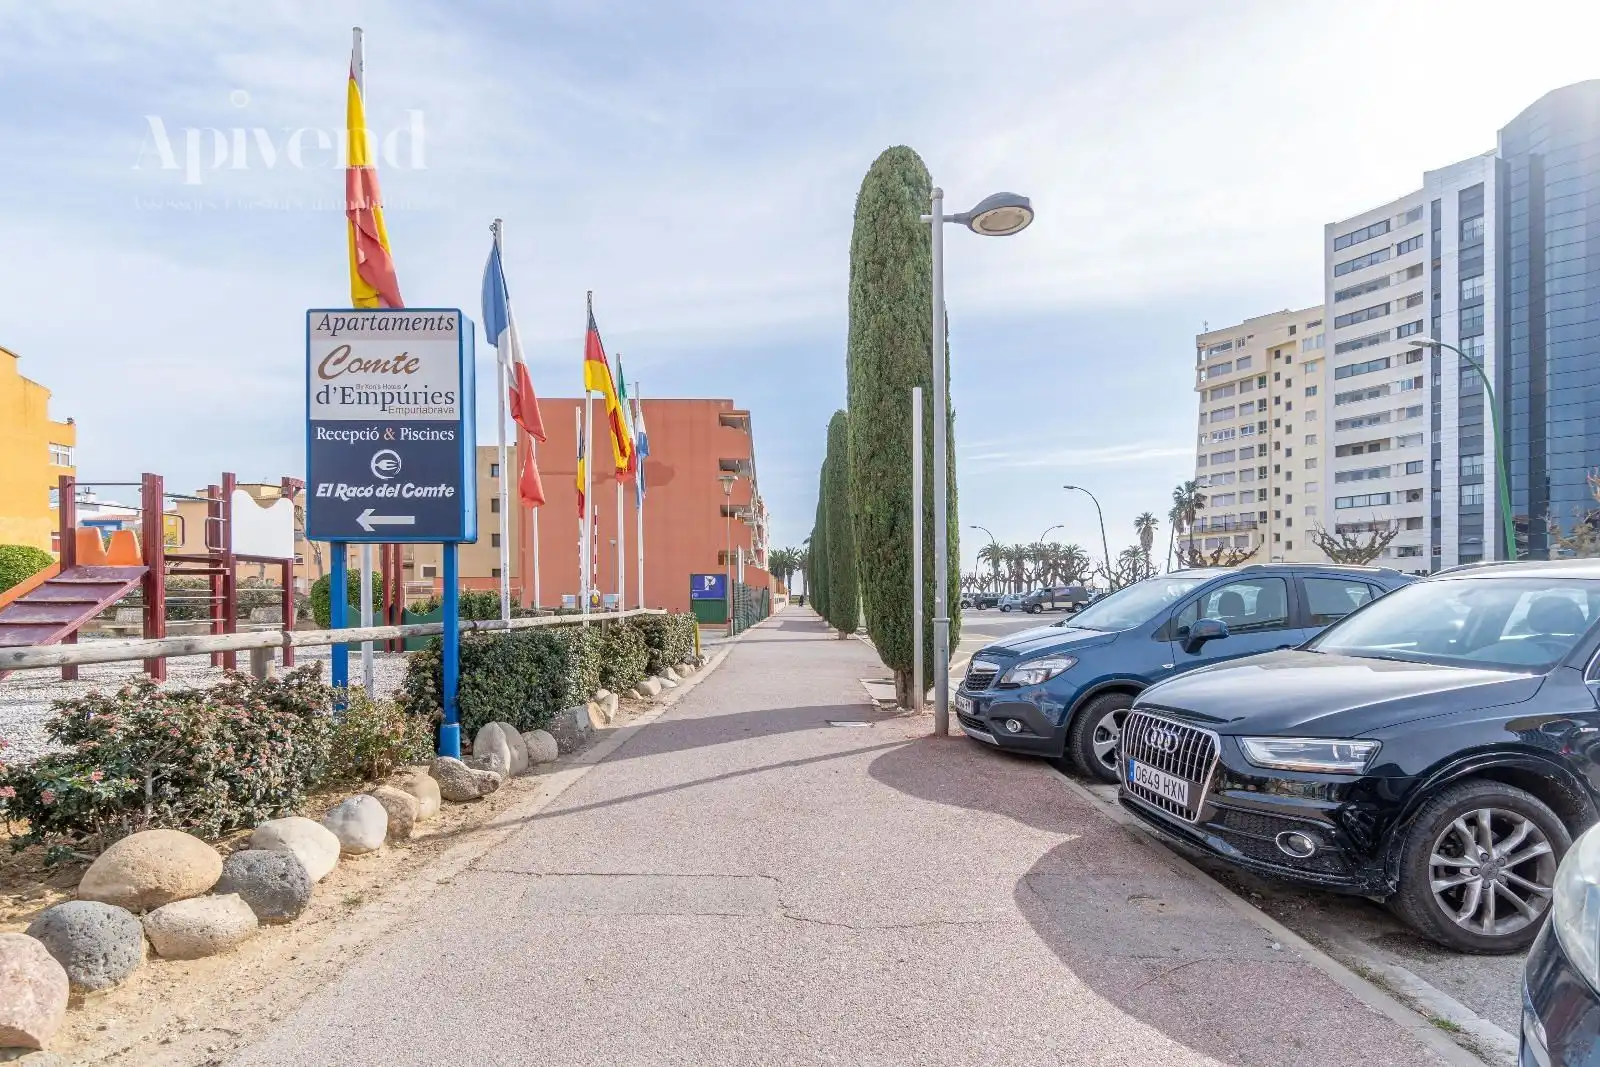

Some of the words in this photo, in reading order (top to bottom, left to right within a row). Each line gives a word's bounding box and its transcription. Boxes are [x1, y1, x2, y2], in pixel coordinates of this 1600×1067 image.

[316, 313, 455, 337] Apartaments
[317, 344, 420, 380] Comte
[388, 405, 455, 415] Empuriabrava
[316, 427, 379, 444] Recepció
[383, 427, 396, 441] &
[400, 427, 454, 441] Piscines
[316, 483, 333, 497] El
[335, 483, 374, 501] Racó
[376, 483, 399, 498] del
[402, 483, 455, 498] Comte
[704, 575, 716, 591] P
[1135, 766, 1160, 790] 0649
[1163, 776, 1186, 803] HXN
